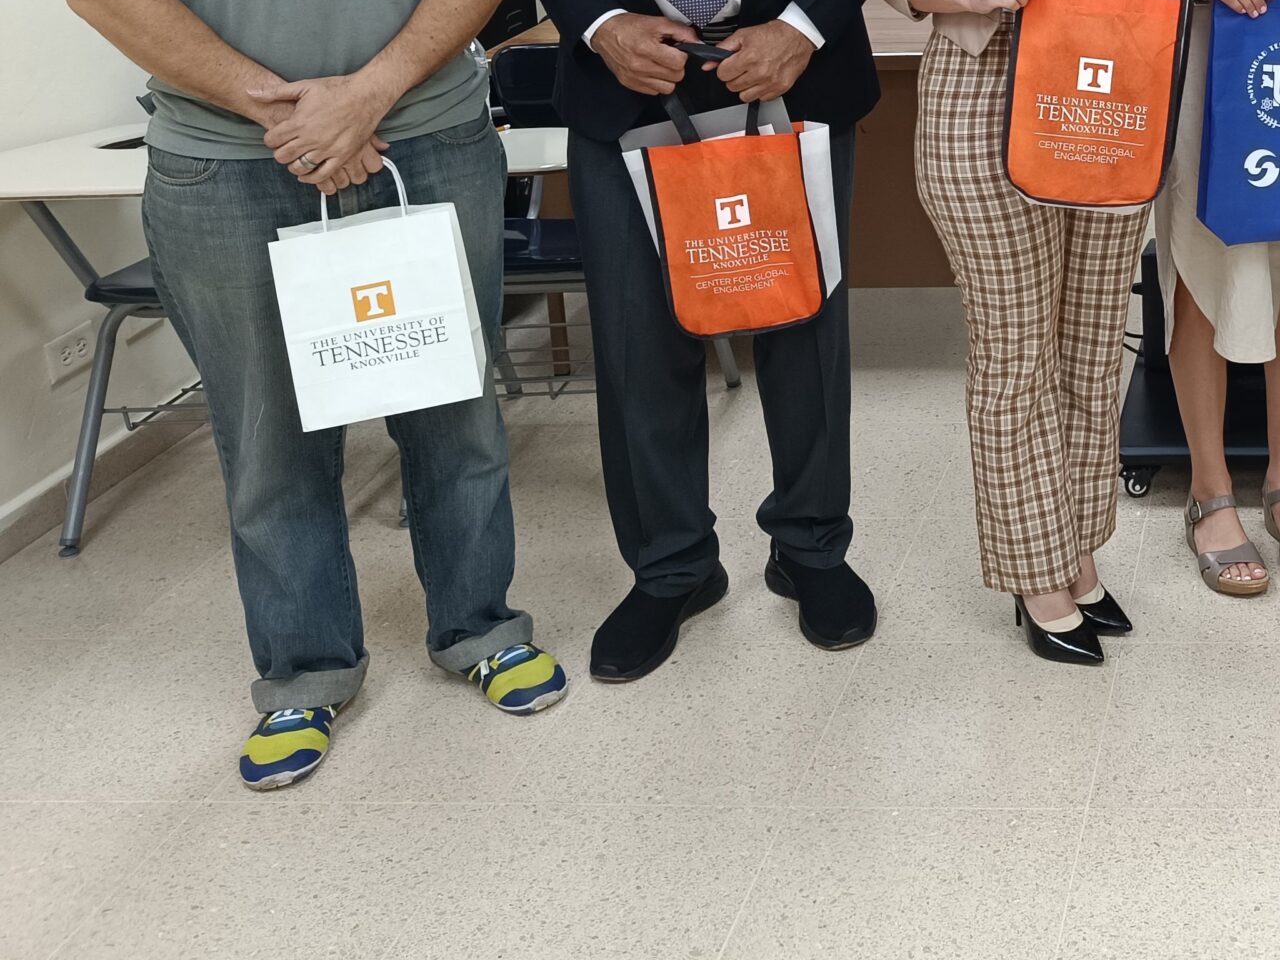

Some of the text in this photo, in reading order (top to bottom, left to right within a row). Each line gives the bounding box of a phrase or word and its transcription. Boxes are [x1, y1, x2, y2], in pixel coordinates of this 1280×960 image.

[1083, 62, 1109, 88] T
[1247, 50, 1268, 104] UNIVERSIDAD
[1037, 94, 1148, 114] THE UNIVERSITY OF
[1036, 103, 1147, 131] TENNESSEE
[1061, 123, 1120, 137] KNOXVILLE
[1039, 140, 1135, 158] CENTER FOR GLOBAL
[1055, 152, 1119, 164] ENGAGEMENT
[720, 199, 744, 225] T
[685, 240, 704, 248] THE
[710, 230, 773, 246] UNIVERSITY
[686, 238, 791, 264] TENNESSEE
[713, 254, 769, 270] KNOXVILLE
[696, 269, 789, 290] CENTER FOR GLOBAL
[714, 279, 775, 294] ENGAGEMENT
[355, 285, 392, 315] T
[310, 316, 445, 350] THE UNIVERSITY OF
[312, 326, 449, 367] TENNESSEE
[350, 349, 420, 370] KNOXVILLE
